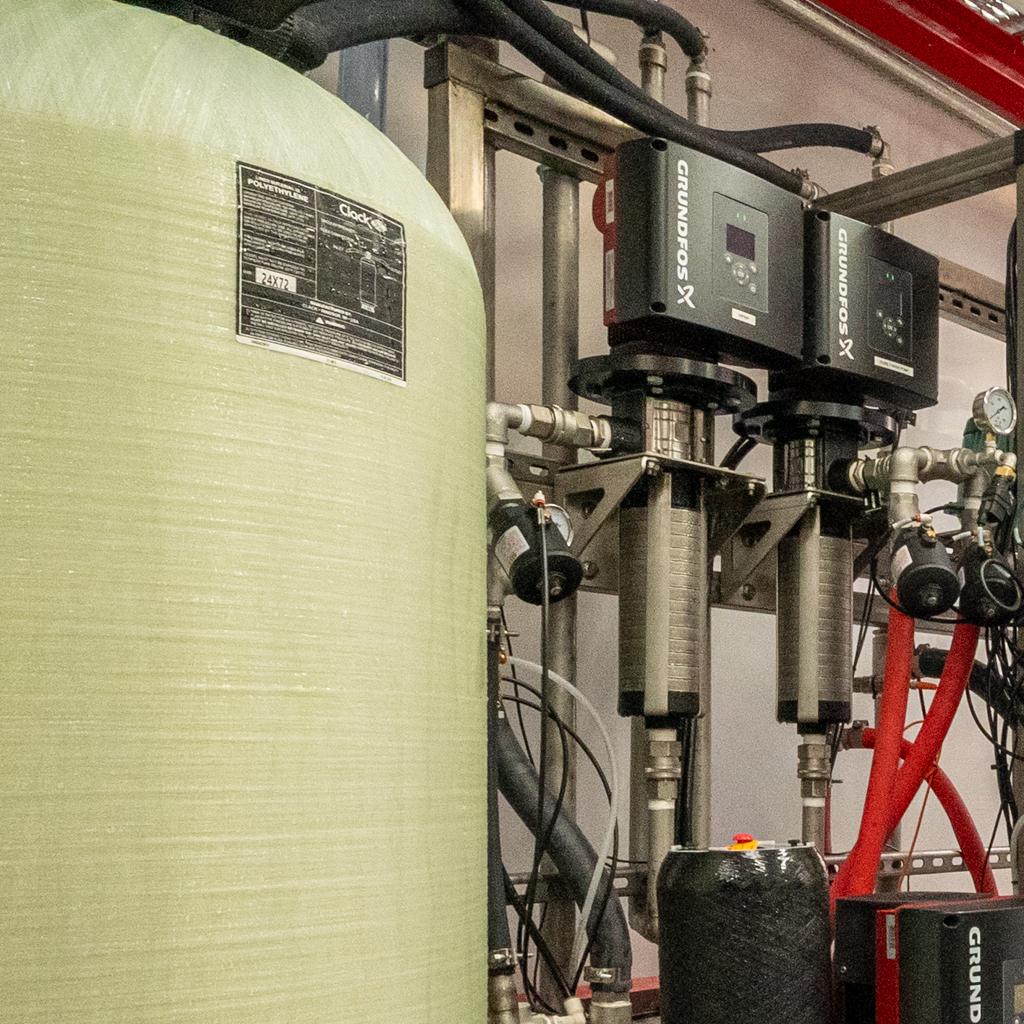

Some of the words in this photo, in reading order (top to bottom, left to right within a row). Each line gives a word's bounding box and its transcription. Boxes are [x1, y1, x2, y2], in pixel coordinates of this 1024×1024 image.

[248, 178, 308, 202] POLYETHYLENE
[339, 202, 373, 229] Clack
[677, 159, 688, 281] GRUNDFOS
[261, 272, 289, 291] 24X72
[838, 228, 848, 336] GRUNDFOS
